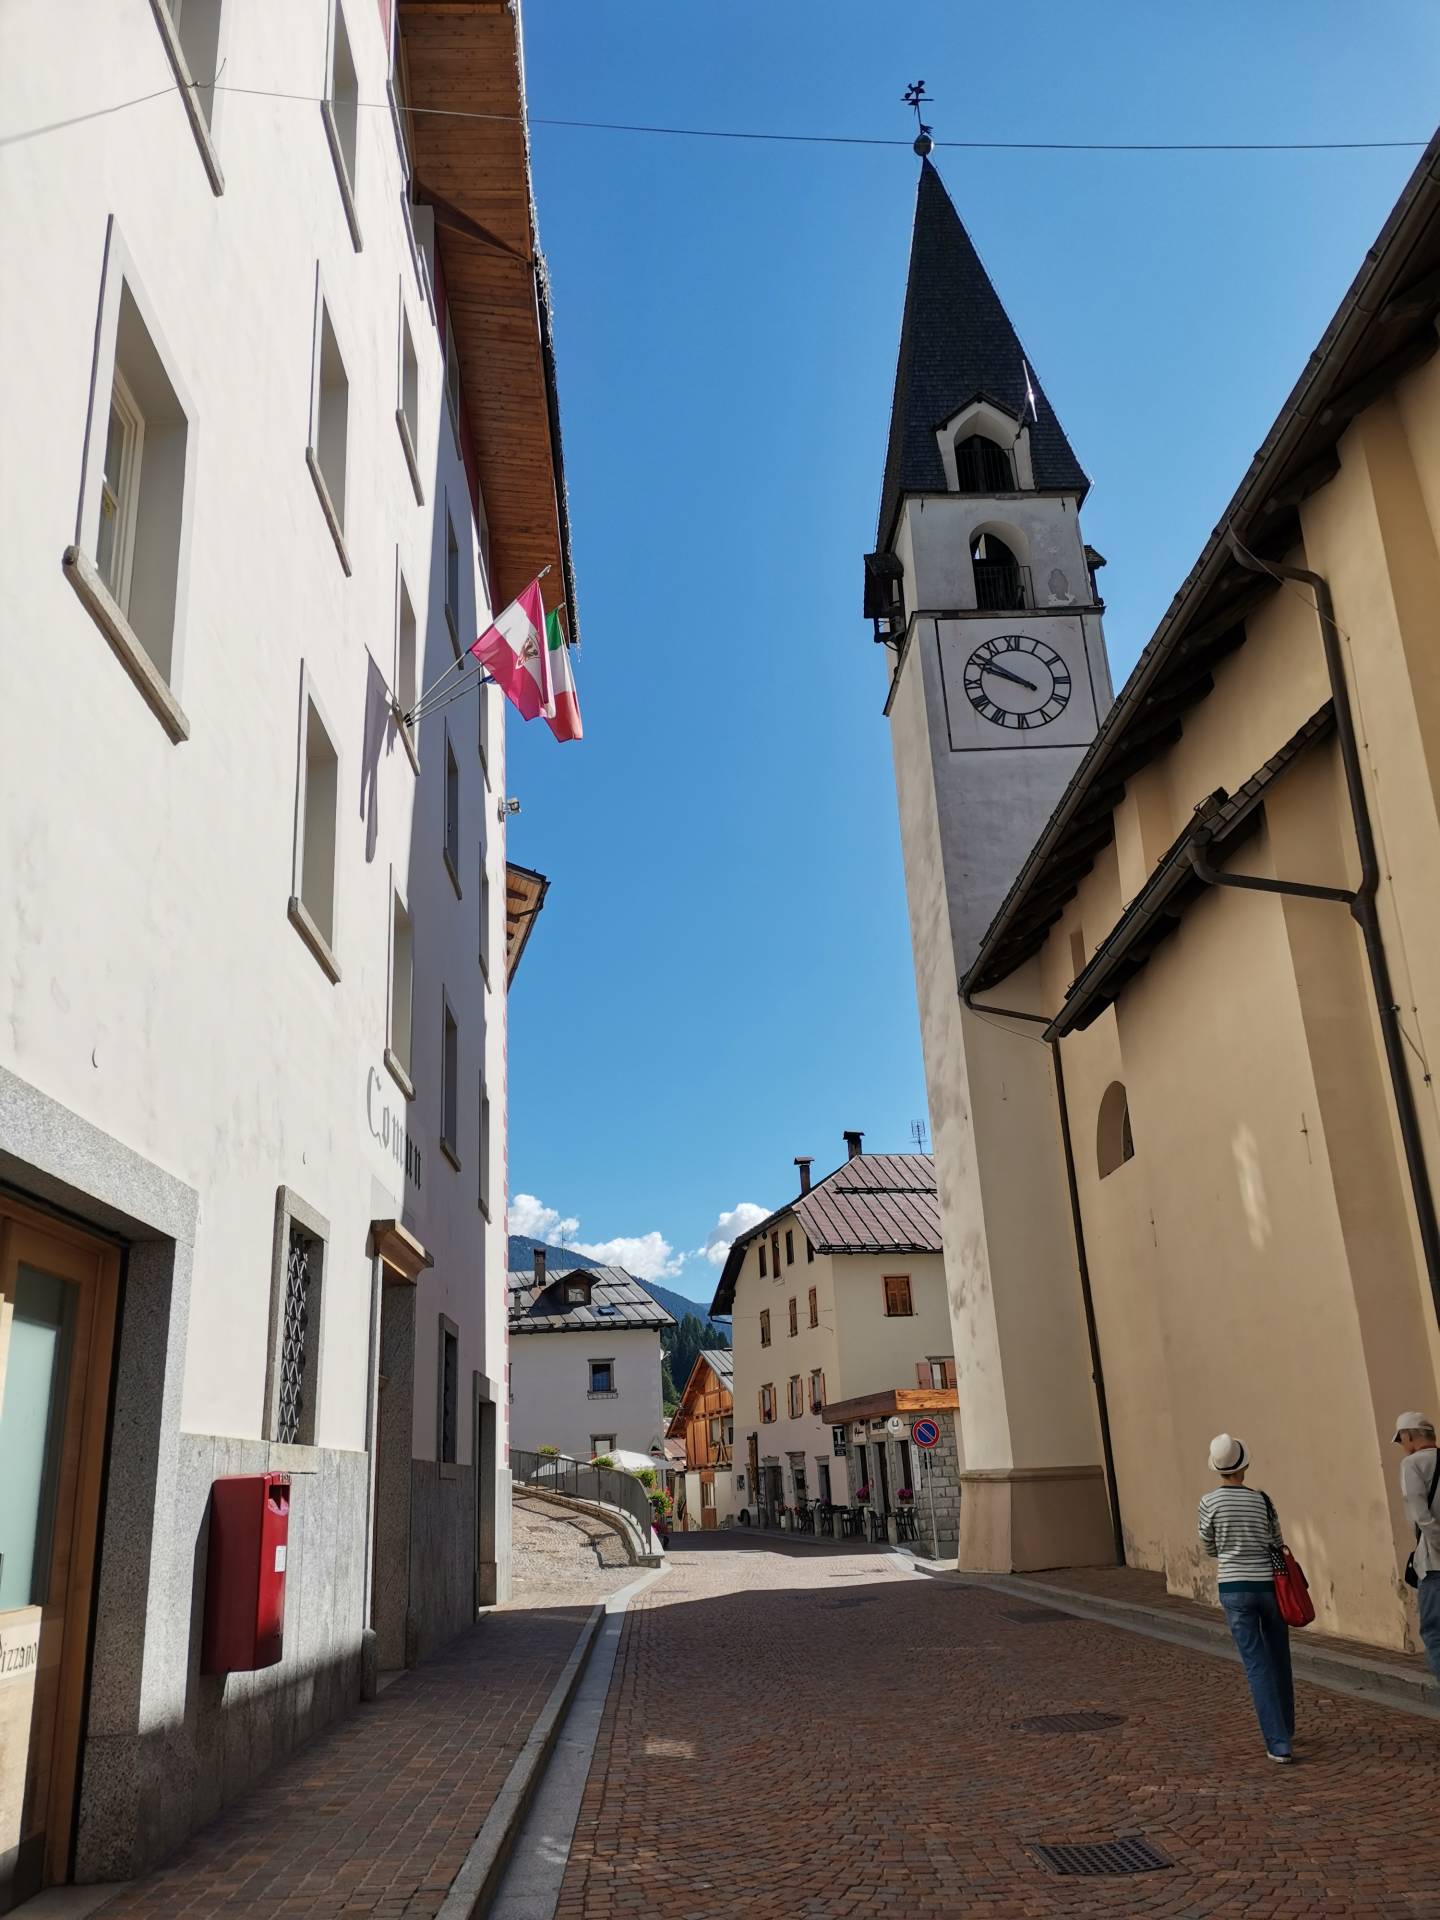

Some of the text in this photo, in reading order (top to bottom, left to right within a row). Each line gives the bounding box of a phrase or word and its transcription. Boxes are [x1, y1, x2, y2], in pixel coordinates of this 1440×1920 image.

[982, 641, 999, 658] XI
[1003, 636, 1020, 651] XII
[967, 658, 985, 671] X
[1045, 655, 1061, 666] II
[965, 678, 982, 690] IX
[1040, 708, 1053, 723] V
